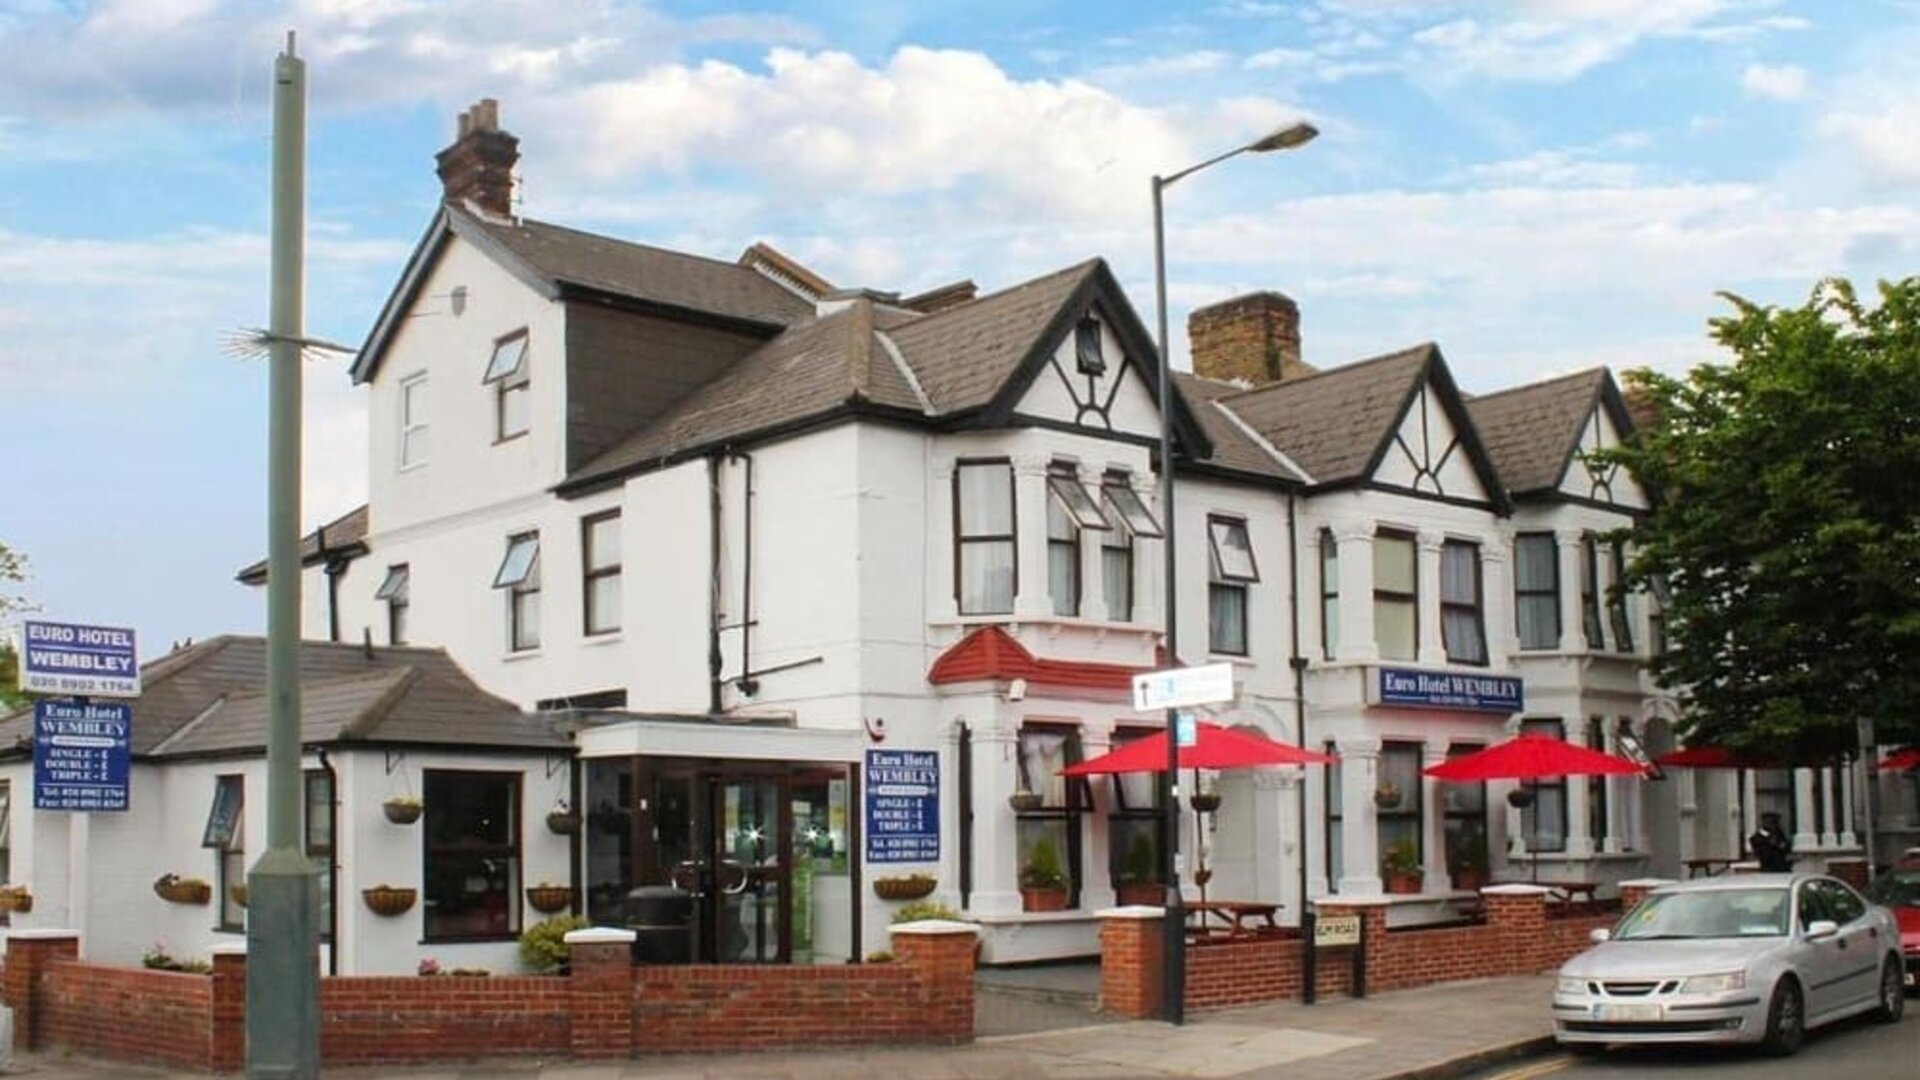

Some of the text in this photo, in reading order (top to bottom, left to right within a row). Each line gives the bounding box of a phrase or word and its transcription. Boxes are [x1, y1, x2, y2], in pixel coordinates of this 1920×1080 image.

[29, 625, 132, 647] EURO HOTEL
[30, 650, 132, 671] WEMBLEY
[30, 676, 57, 687] 020
[60, 679, 96, 690] 8902
[1384, 671, 1518, 698] Euro Hotel WEMBLEY
[45, 704, 124, 720] Euro Hotel
[41, 721, 127, 736] WEMBLEY
[50, 749, 93, 758] SINGLE
[872, 752, 935, 767] Euro Hotel
[45, 760, 92, 769] DOUBLE
[50, 770, 92, 780] TRIPLE
[868, 769, 937, 783] WEMBLEY
[873, 810, 909, 820] DOUBLE
[878, 821, 909, 832] TRIPLE
